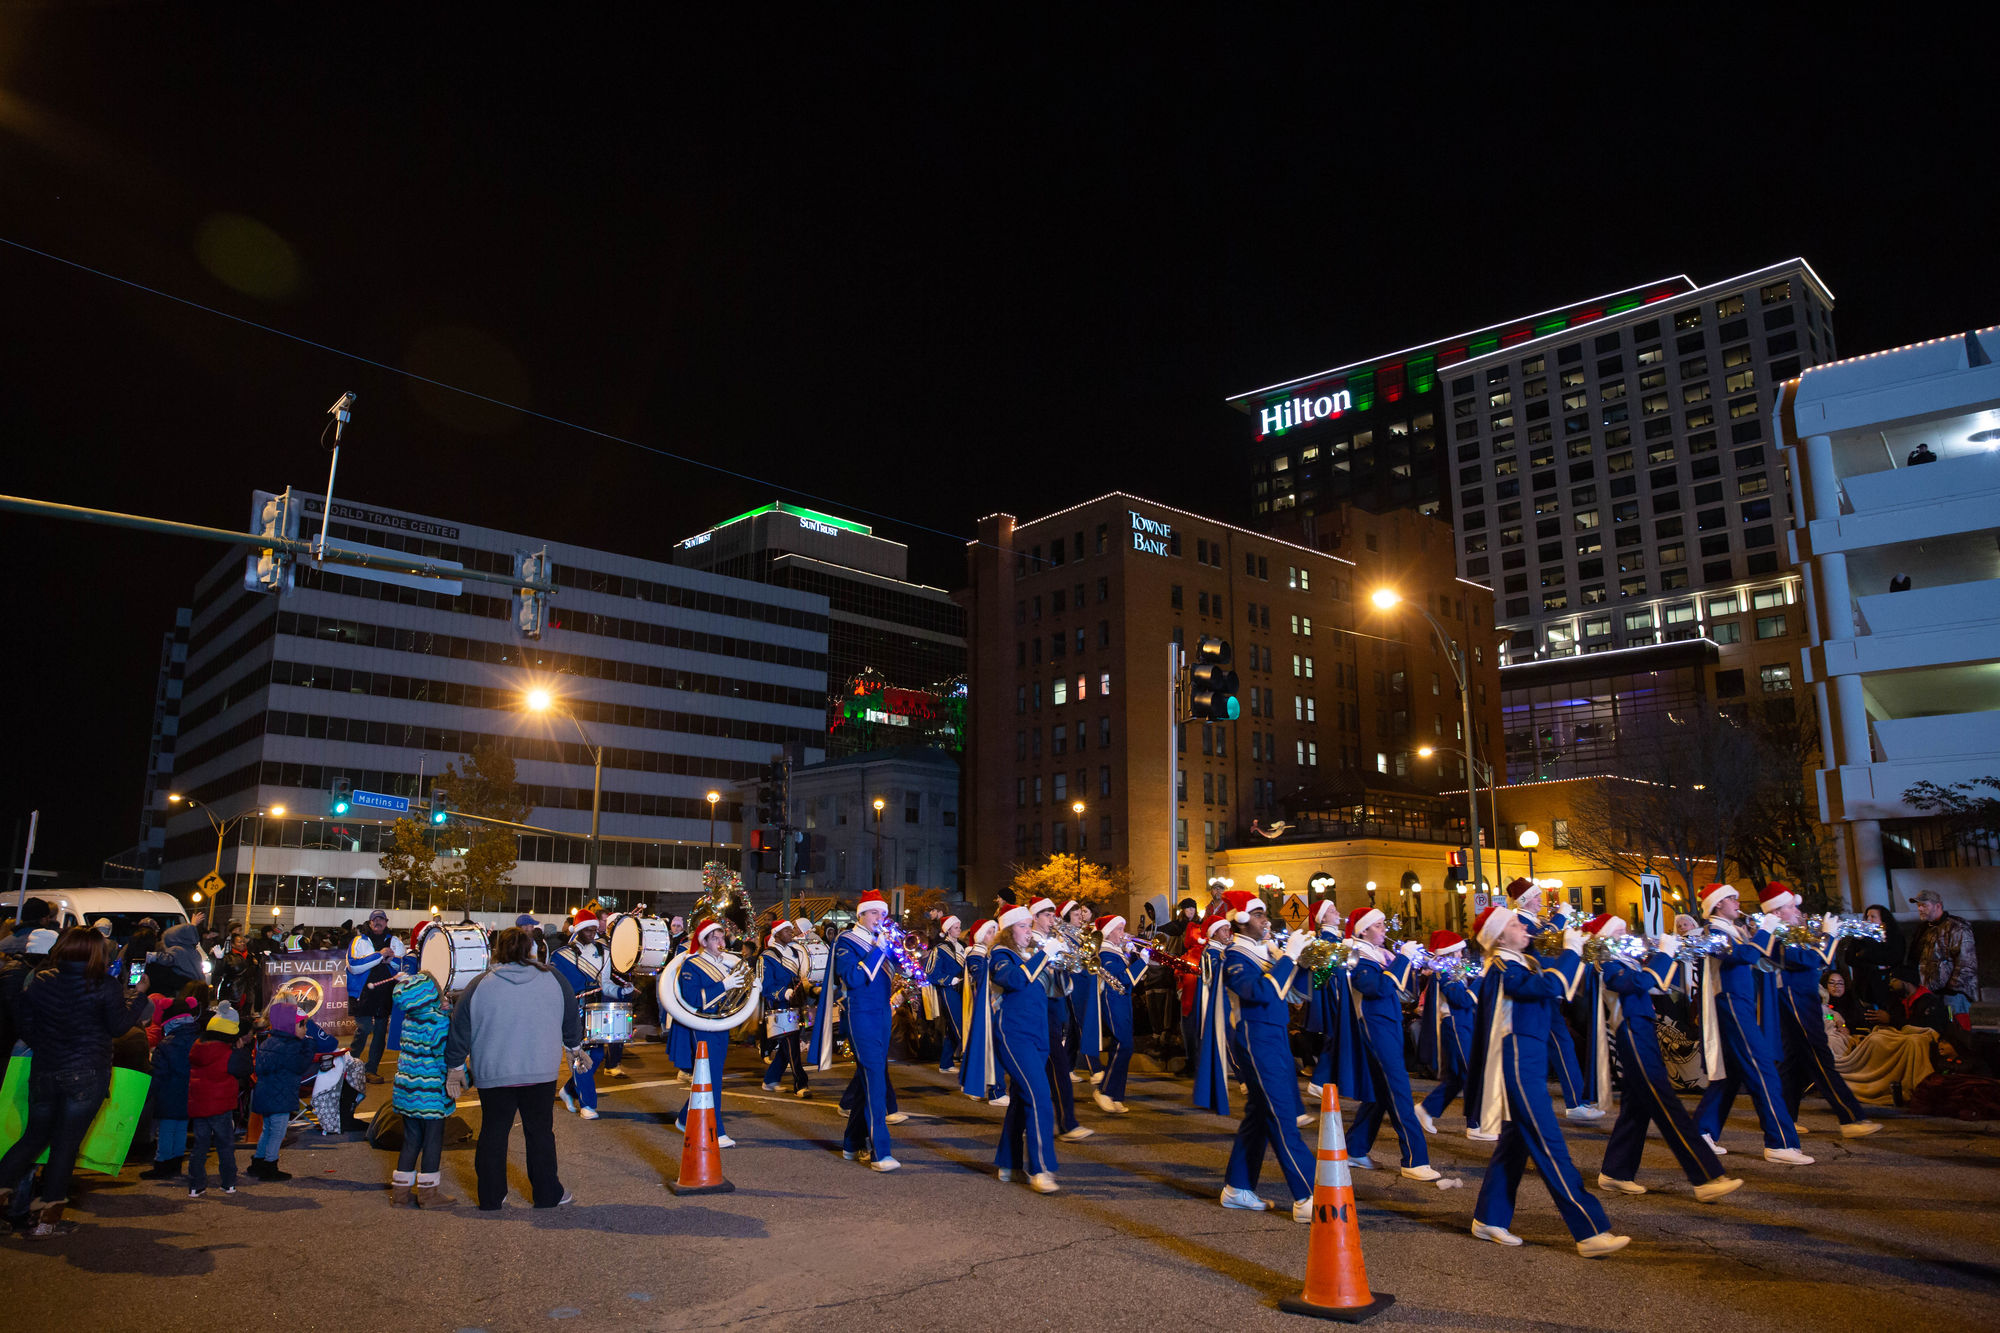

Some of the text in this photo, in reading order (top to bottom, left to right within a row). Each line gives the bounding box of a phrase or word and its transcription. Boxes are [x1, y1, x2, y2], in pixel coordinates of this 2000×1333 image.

[1260, 389, 1352, 435] Hilton
[319, 502, 457, 538] WORLD TRADE CENTER
[1128, 510, 1171, 538] TOWNE
[1133, 532, 1168, 557] BANK
[358, 795, 393, 807] Martins
[265, 961, 292, 973] THE
[294, 960, 342, 973] VALLEY
